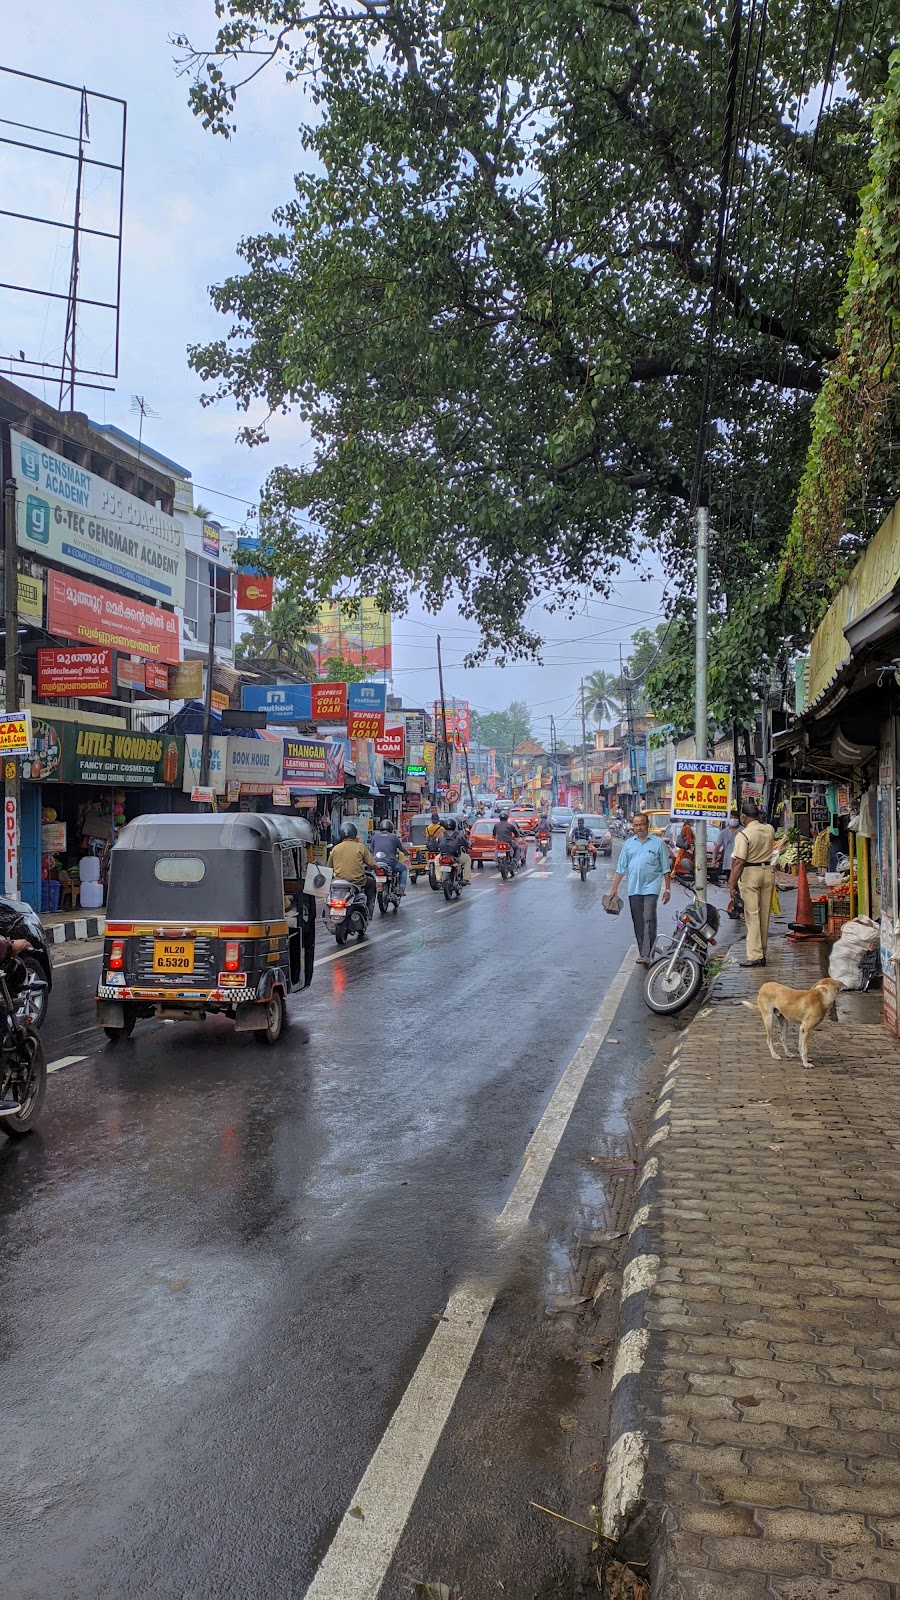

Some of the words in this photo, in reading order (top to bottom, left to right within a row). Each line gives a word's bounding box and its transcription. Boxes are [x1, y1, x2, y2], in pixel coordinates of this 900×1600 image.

[42, 452, 91, 491] GENSMART
[46, 474, 89, 508] ACADEMY
[54, 505, 84, 535] G-TEC
[88, 521, 139, 558] GENSMART
[141, 546, 179, 576] ACADEMY
[72, 548, 96, 565] COMPLETE
[97, 558, 113, 571] CAREER
[114, 564, 135, 579] COACHING
[136, 575, 150, 586] CENTRE
[353, 720, 378, 730] GOLD
[352, 729, 378, 738] LOAN
[76, 730, 112, 758] LITTLE
[114, 735, 163, 762] WONDERS
[288, 743, 325, 759] THANGAM
[80, 761, 104, 770] FANCY
[105, 762, 119, 771] GIFT
[120, 764, 155, 773] COSMETICS
[232, 751, 250, 765] BOOK
[250, 753, 270, 767] HOUSE
[678, 763, 699, 771] RANK
[700, 764, 728, 772] CENTRE
[158, 958, 189, 968] G.5320
